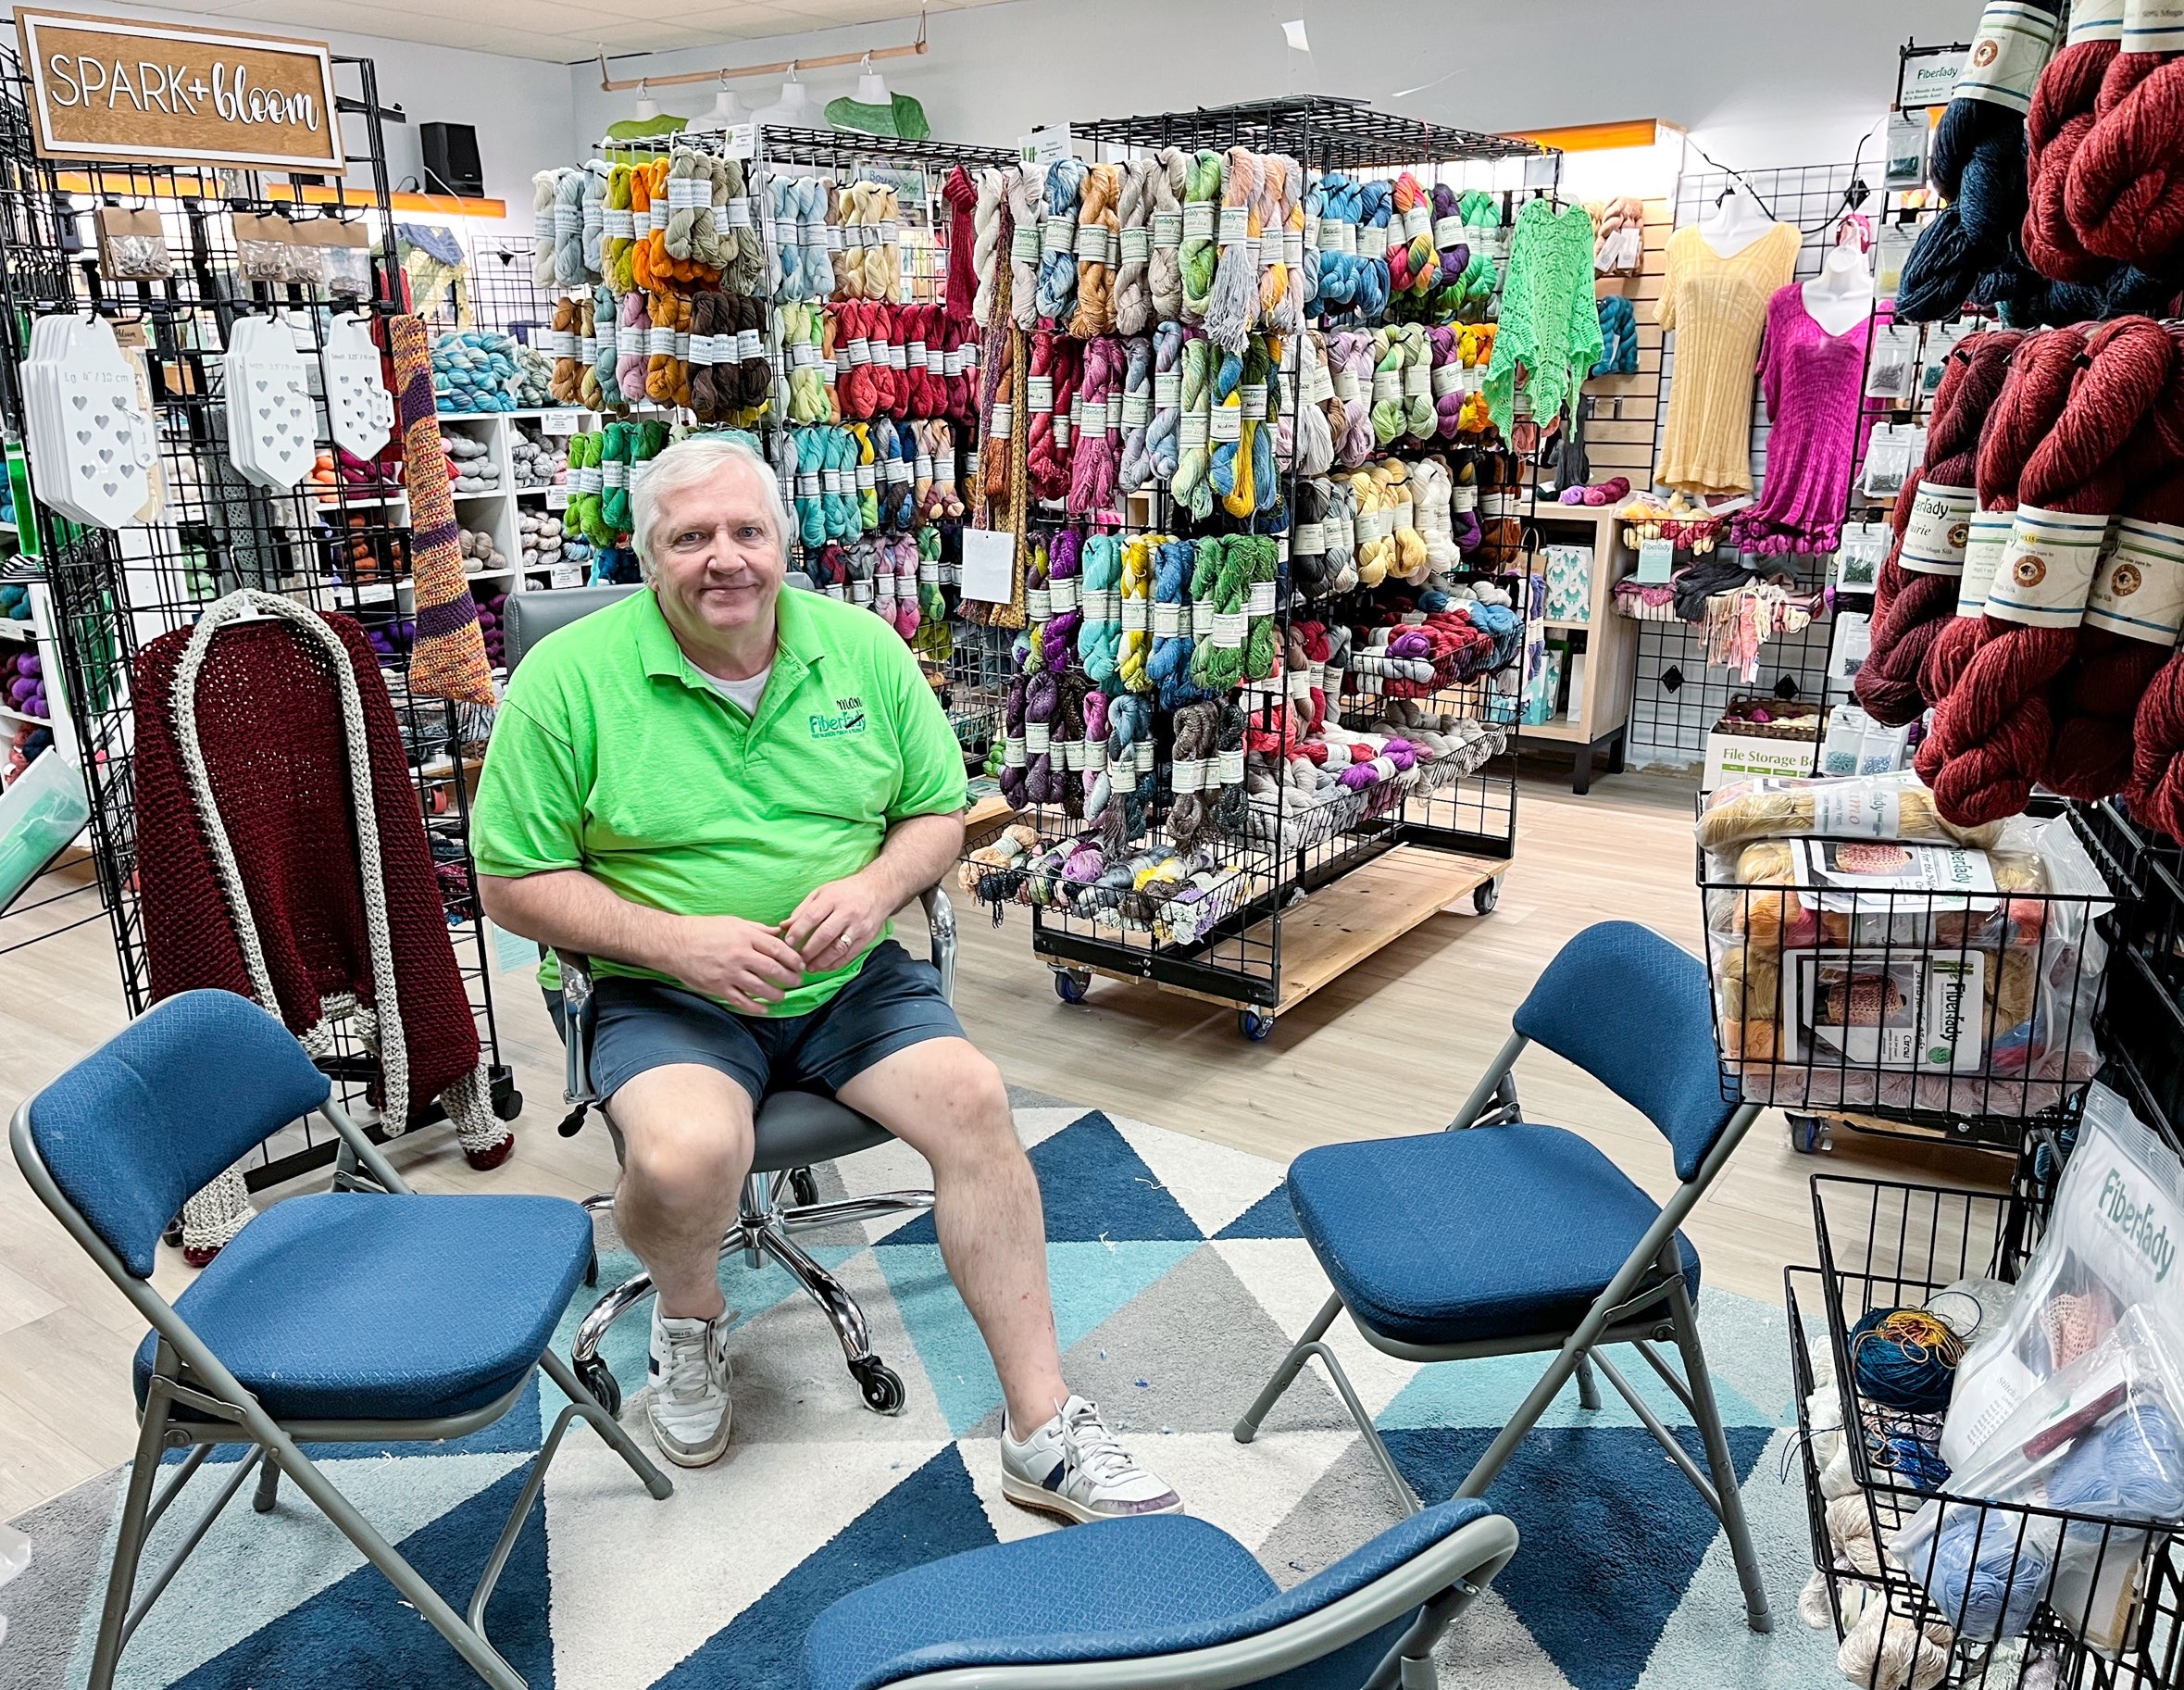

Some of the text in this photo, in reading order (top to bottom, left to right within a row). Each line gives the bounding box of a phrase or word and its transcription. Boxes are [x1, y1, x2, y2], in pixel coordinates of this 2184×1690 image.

[1917, 66, 1959, 80] Fiberlady
[64, 371, 77, 383] Lg
[115, 374, 129, 382] cm
[1723, 747, 1822, 767] File Storage Bo
[1939, 983, 1966, 1043] Fiberlady
[1903, 1034, 1913, 1059] Circus
[2098, 1167, 2176, 1283] Fiberlady
